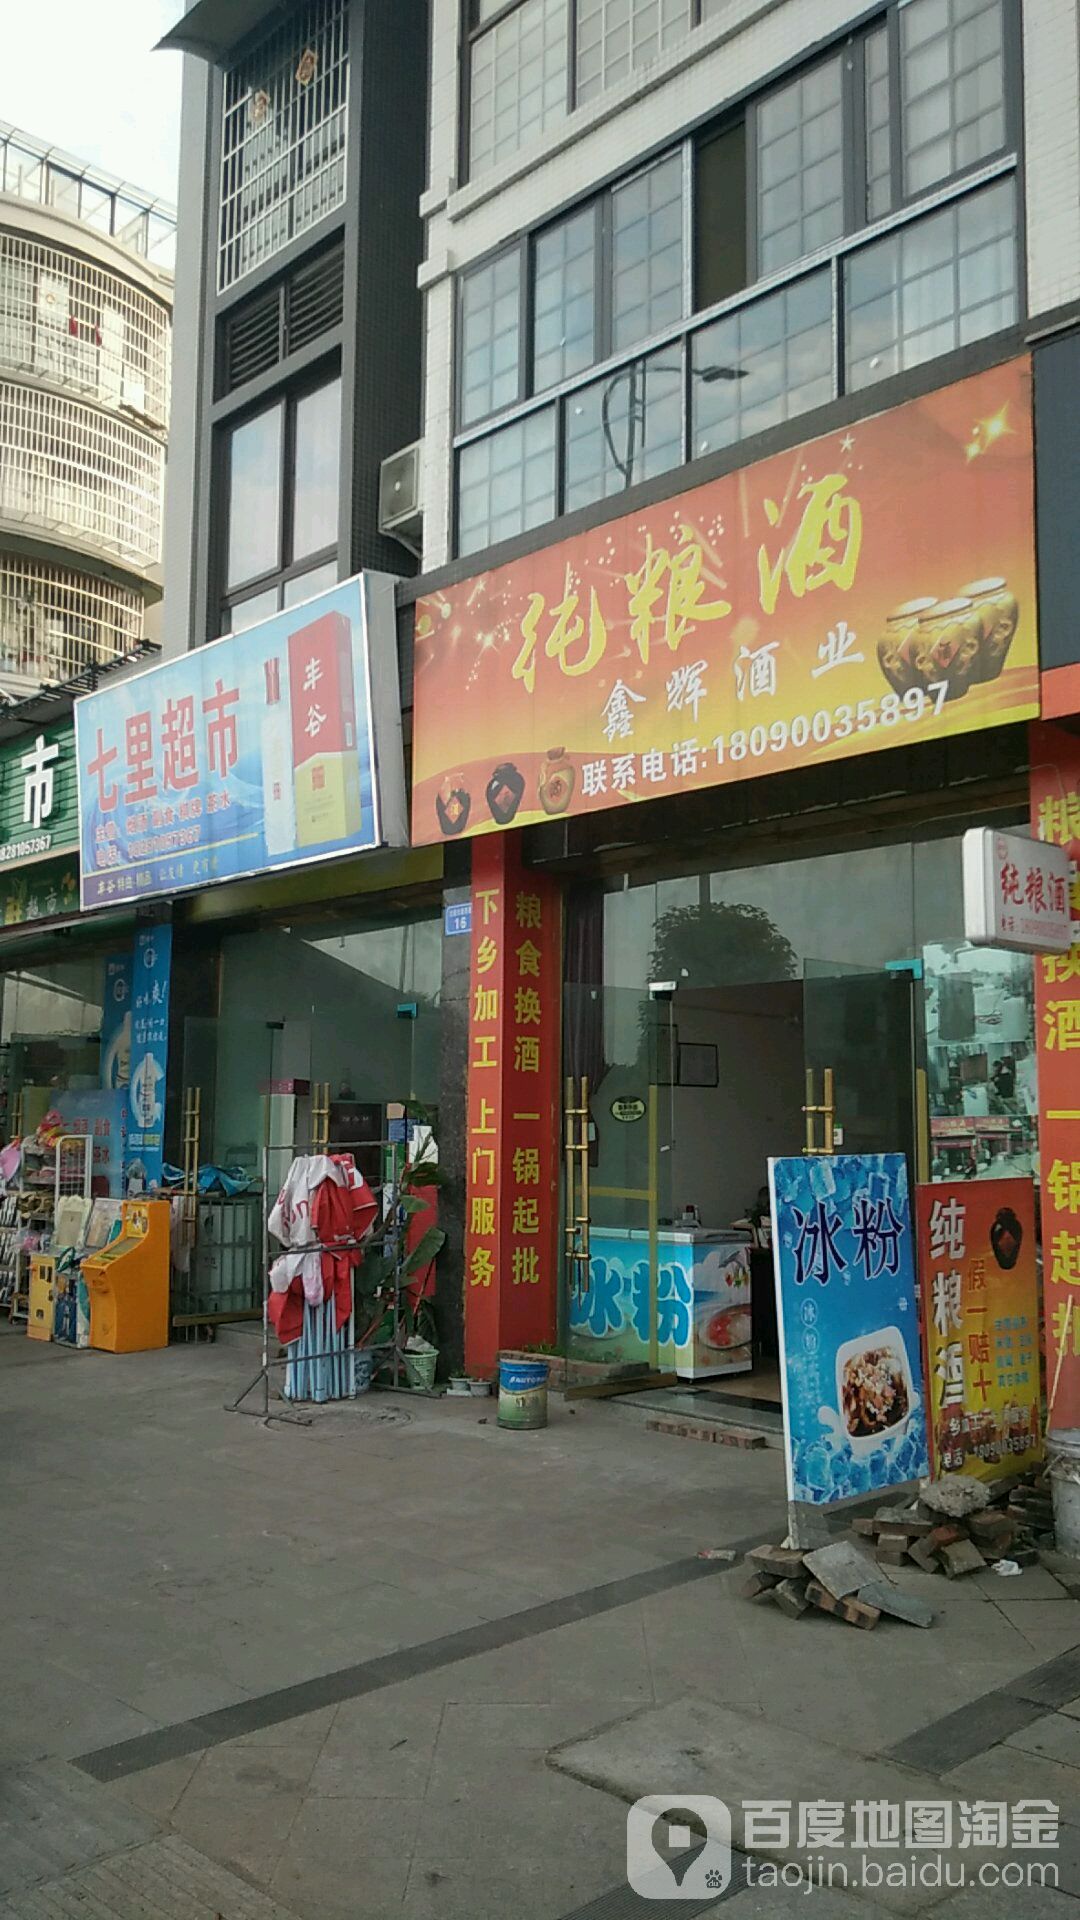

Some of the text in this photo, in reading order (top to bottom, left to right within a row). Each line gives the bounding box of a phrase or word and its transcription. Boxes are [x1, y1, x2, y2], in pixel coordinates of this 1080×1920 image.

[512, 474, 863, 694] 纯粮酒
[302, 657, 328, 738] 丰谷
[601, 622, 865, 741] 鑫辉酒业
[21, 735, 59, 828] 市
[86, 679, 240, 813] 七里超市
[455, 916, 467, 929] 16
[1000, 863, 1066, 914] 纯粮酒
[470, 889, 499, 1287] 下乡加工上门服务
[512, 891, 542, 1285] 粮食换酒一锅起批
[792, 1197, 905, 1286] 冰粉
[966, 1258, 992, 1402] 假一赔十
